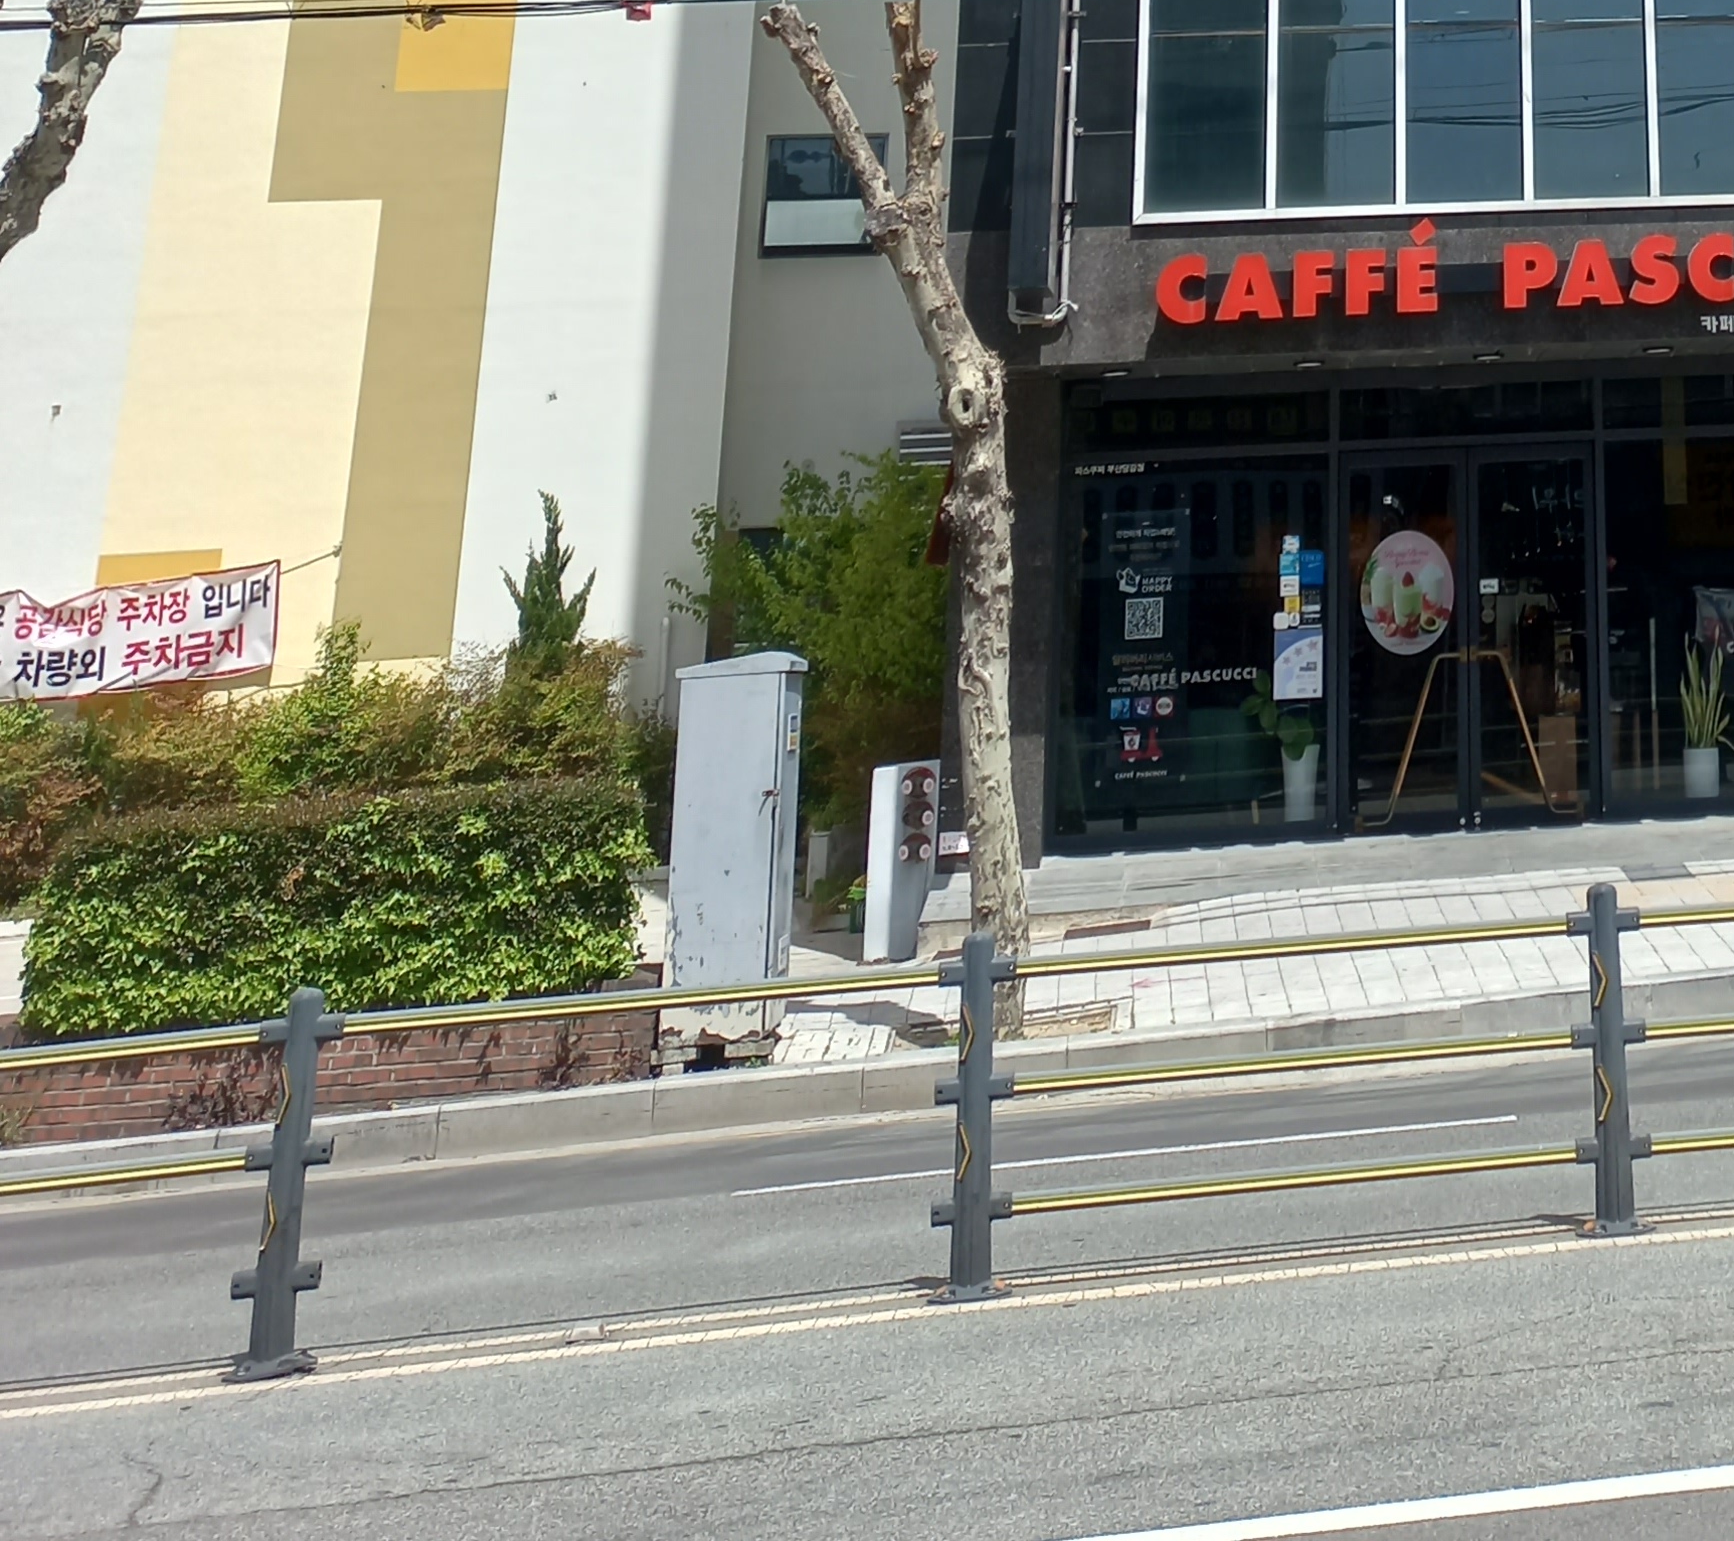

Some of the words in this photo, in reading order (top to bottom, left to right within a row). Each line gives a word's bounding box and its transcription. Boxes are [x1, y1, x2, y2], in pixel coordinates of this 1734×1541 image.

[1155, 217, 1439, 325] CAFFÉ
[1141, 576, 1173, 585] HAPPY
[1141, 584, 1173, 594] ORDER
[117, 588, 191, 632] 주차장
[201, 573, 271, 619] 입니다
[13, 645, 106, 689] 차량외
[122, 622, 245, 677] 주차금지
[1131, 668, 1177, 687] CAFFÉ
[1180, 667, 1257, 684] PASCUCCI
